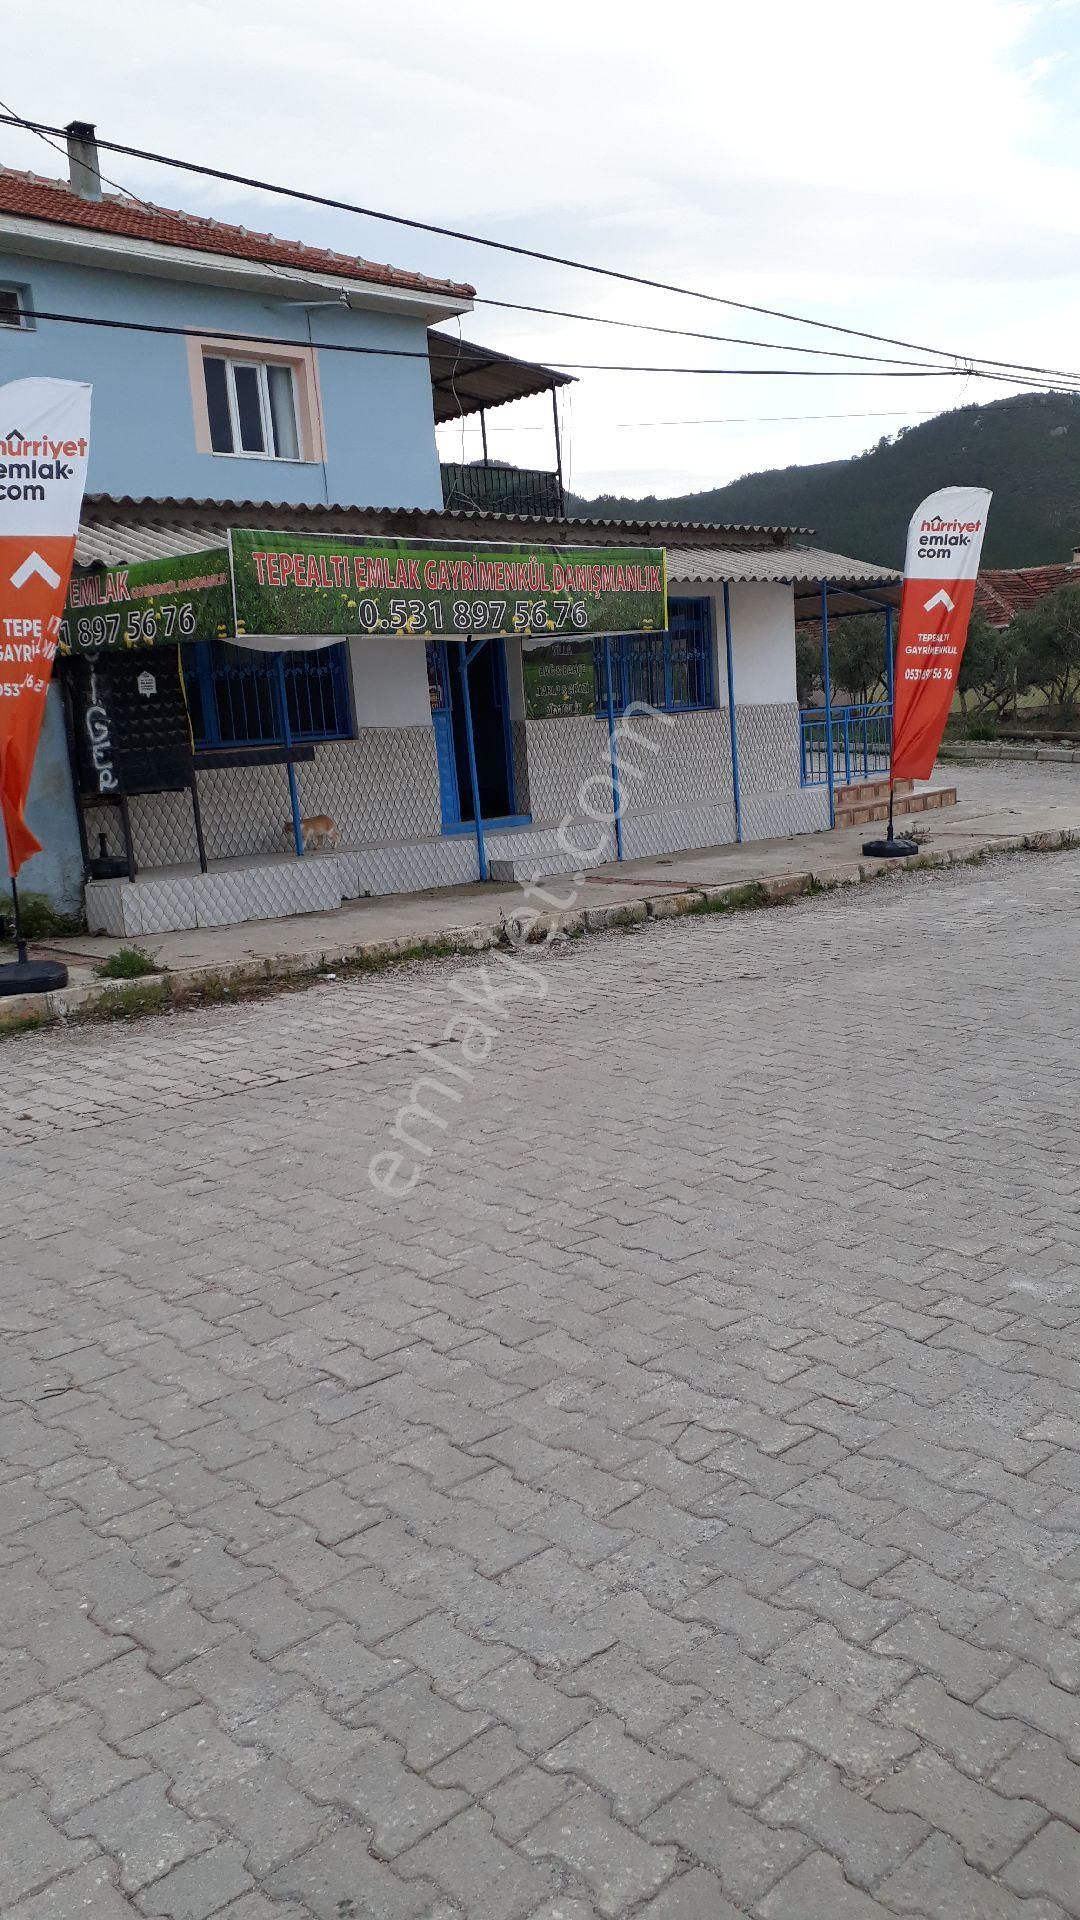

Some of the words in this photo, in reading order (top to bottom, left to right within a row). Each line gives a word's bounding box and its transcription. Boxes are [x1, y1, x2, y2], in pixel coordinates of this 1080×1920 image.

[917, 548, 951, 559] com
[70, 570, 131, 609] EMLAK
[252, 552, 350, 588] TEPEALTI
[354, 557, 422, 589] EMLAK
[552, 563, 662, 599] DANIŞMANLIK
[78, 612, 121, 648] 897
[128, 608, 157, 641] 56
[161, 603, 195, 636] 76
[359, 598, 443, 629] 0.531
[453, 600, 506, 629] 897
[515, 600, 548, 629] 56
[553, 600, 588, 628] 76
[932, 667, 942, 680] 56
[943, 667, 953, 680] 76
